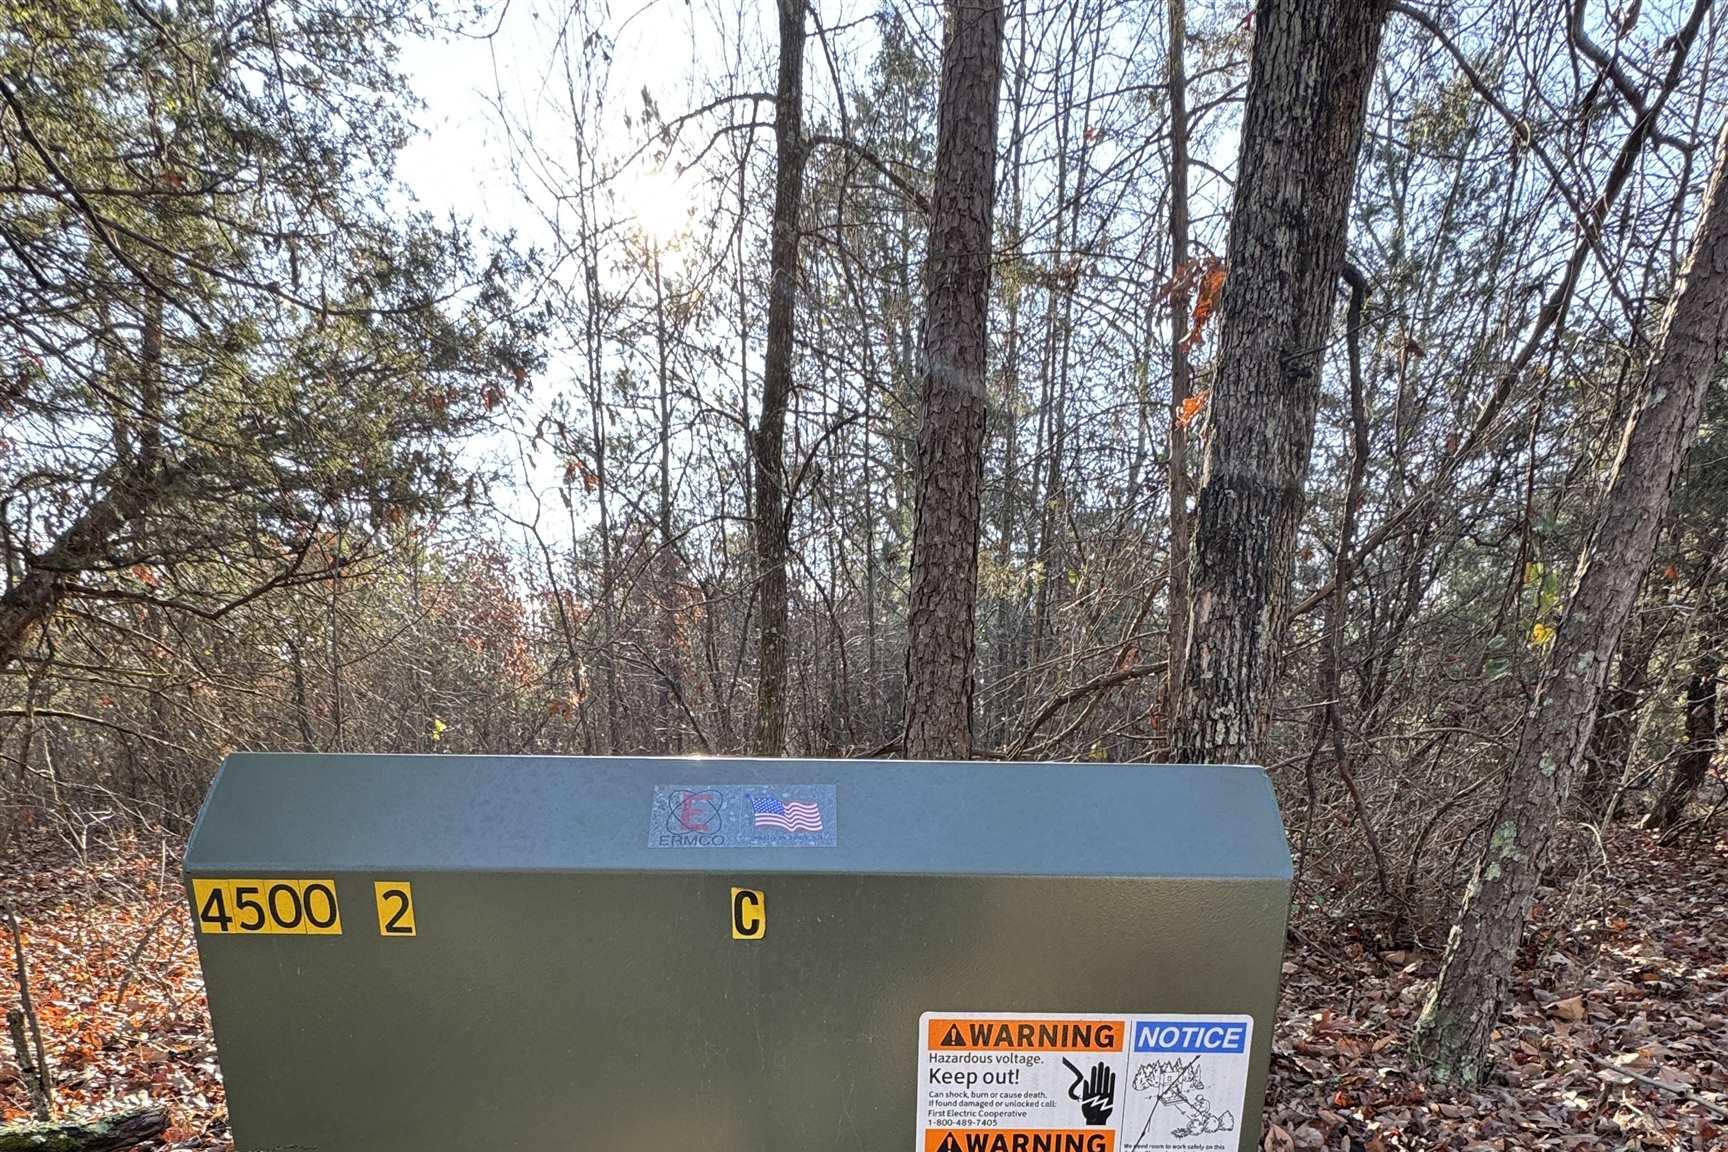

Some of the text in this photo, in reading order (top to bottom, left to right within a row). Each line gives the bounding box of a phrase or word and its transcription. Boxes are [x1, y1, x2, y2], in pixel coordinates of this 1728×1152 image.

[659, 835, 725, 846] ERMCO
[200, 884, 337, 931] 4500
[382, 889, 413, 933] 2
[734, 890, 760, 936] C
[969, 1023, 1114, 1048] WARNING
[1137, 1027, 1243, 1048] NOTICE
[929, 1052, 1044, 1067] Hazardous voltage.
[929, 1068, 1020, 1089] Keep out!
[945, 1091, 969, 1099] shock,
[958, 1100, 993, 1108] damaged
[978, 1110, 1027, 1119] Cooperative
